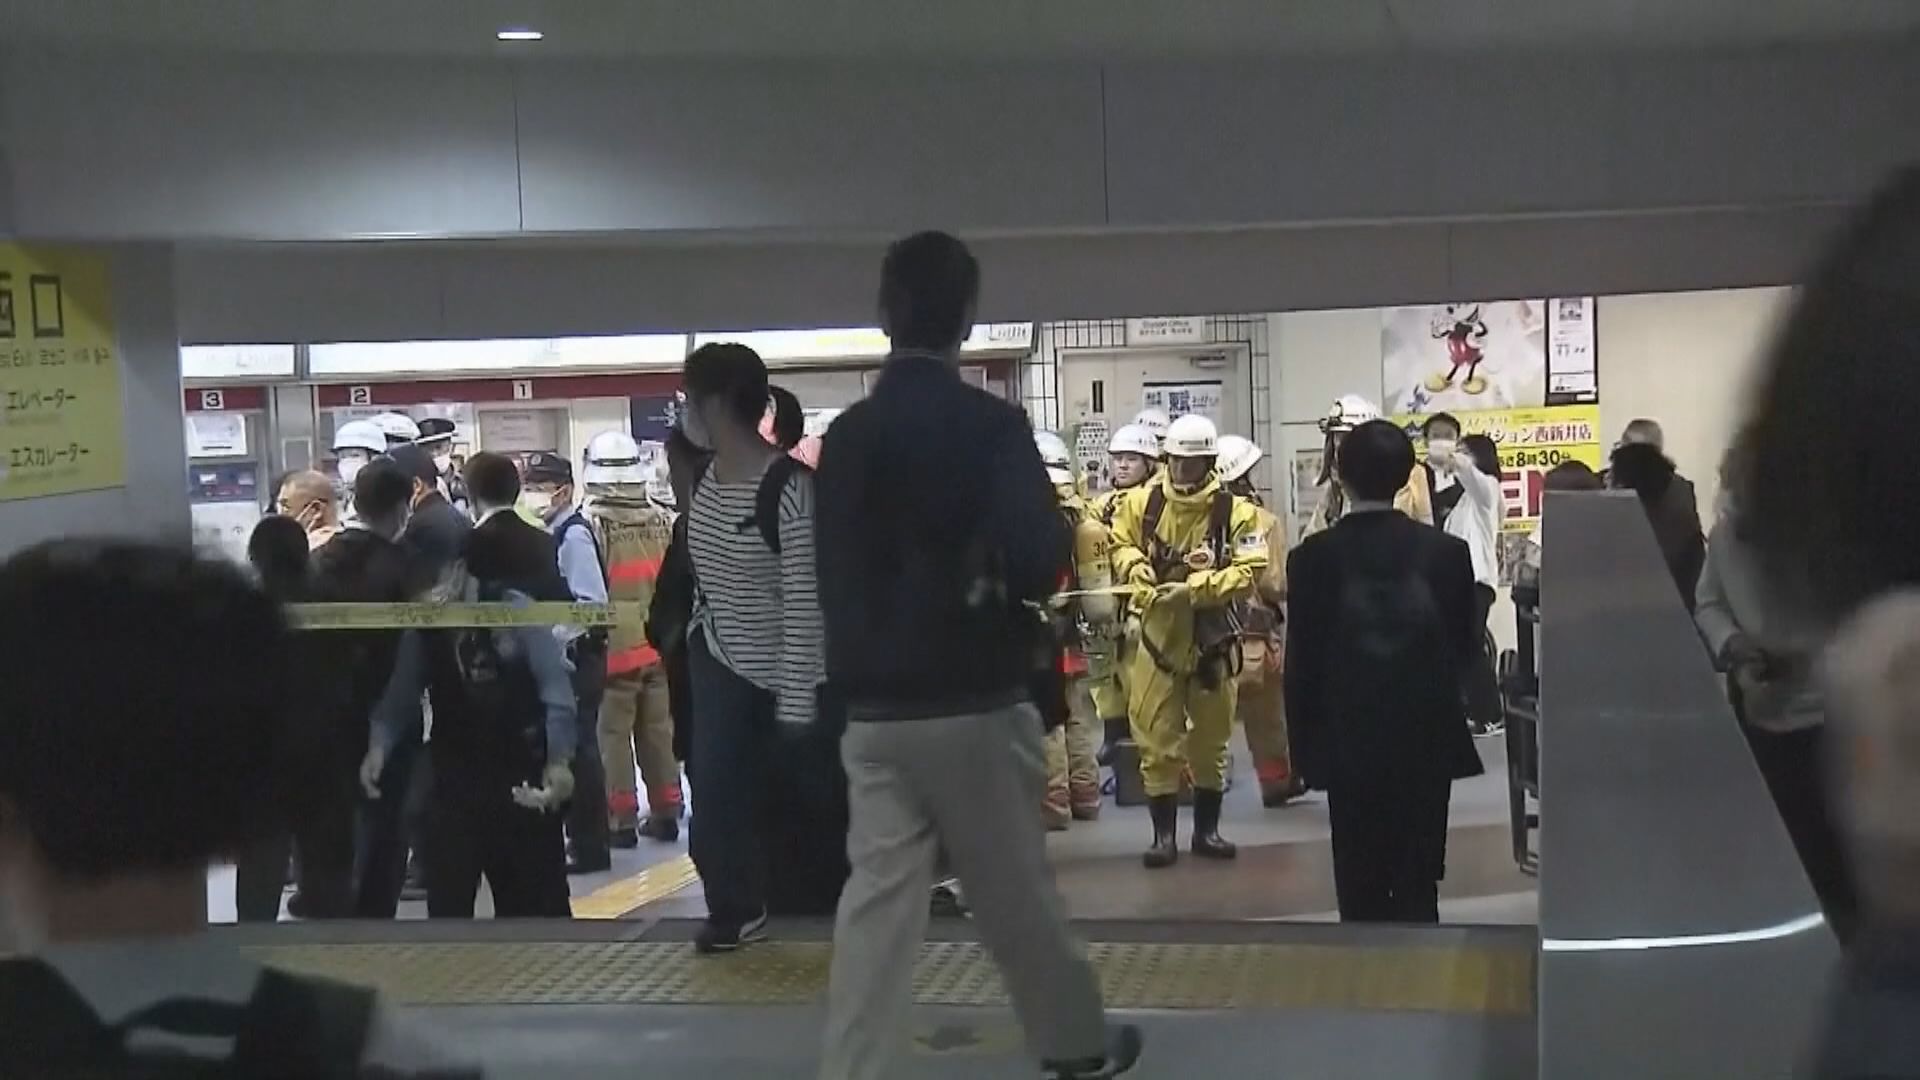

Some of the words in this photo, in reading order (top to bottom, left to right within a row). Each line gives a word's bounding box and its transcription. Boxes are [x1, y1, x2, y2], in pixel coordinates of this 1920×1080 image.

[354, 388, 367, 403] 2
[520, 384, 525, 397] 1
[7, 388, 77, 410] エレベーター
[206, 392, 220, 407] 3
[10, 442, 90, 467] エスカレーター
